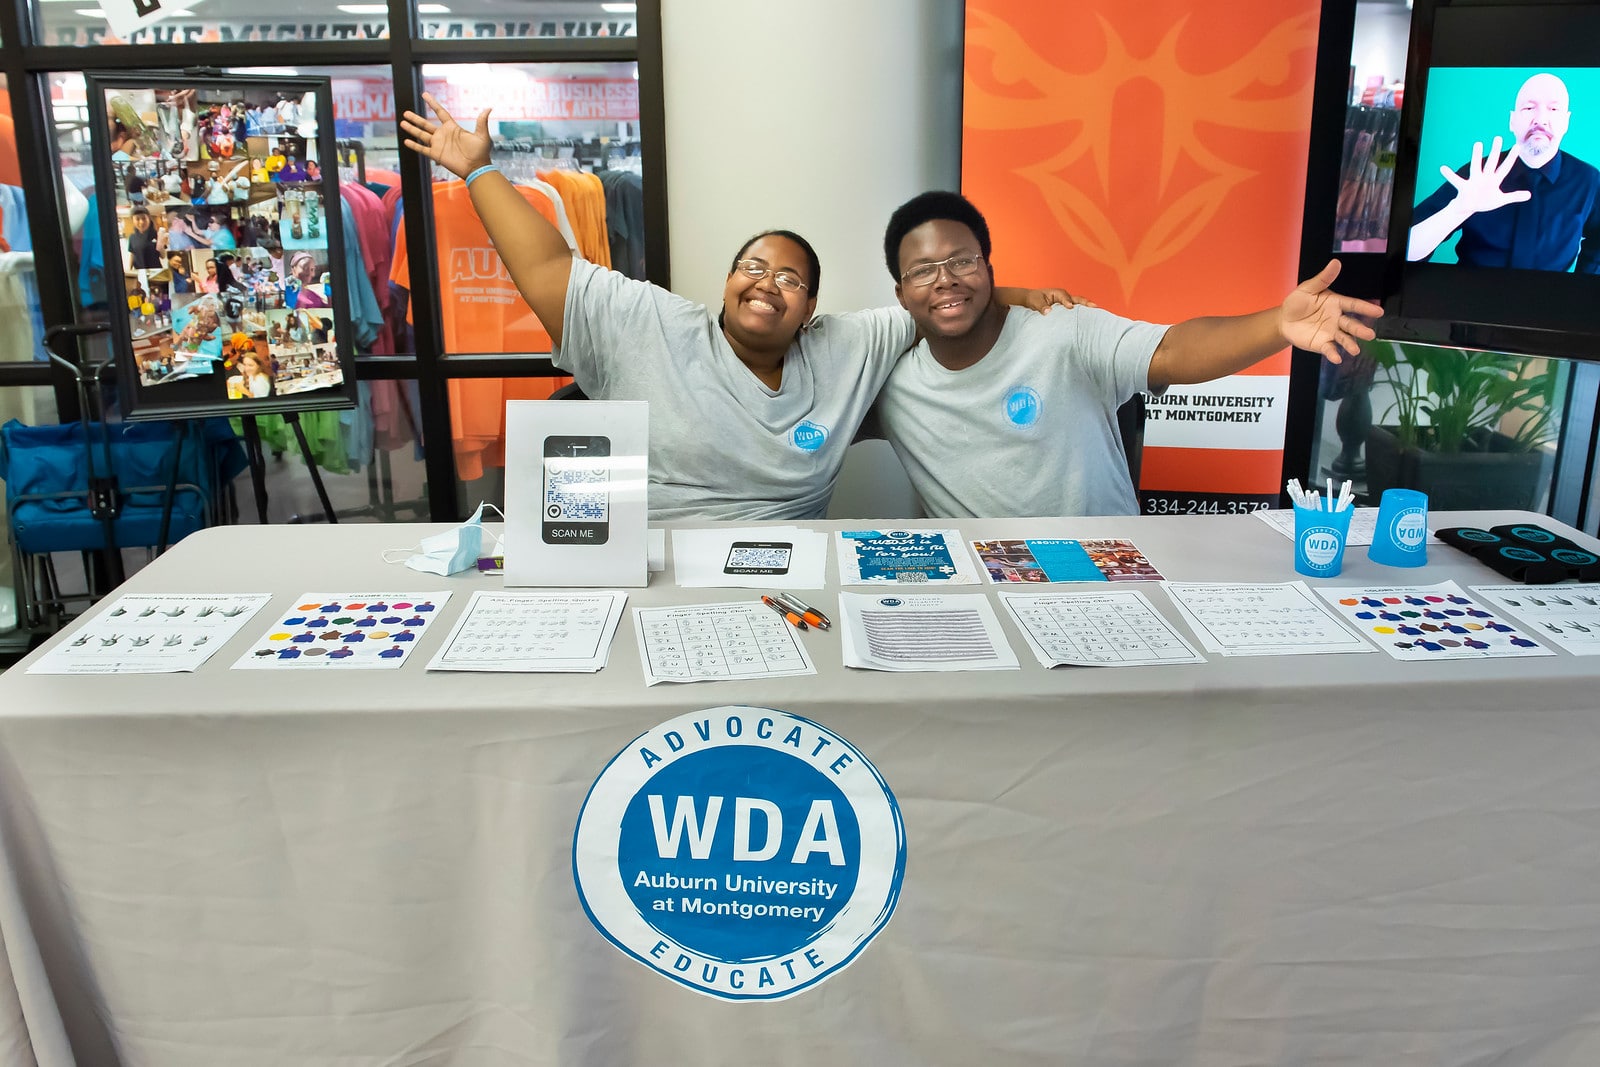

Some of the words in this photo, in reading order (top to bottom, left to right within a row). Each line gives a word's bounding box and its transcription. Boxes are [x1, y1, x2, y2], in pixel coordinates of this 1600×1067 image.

[548, 83, 637, 100] BUSINESS
[572, 101, 606, 118] ARTS
[1008, 396, 1036, 412] WDA
[1192, 395, 1274, 408] UNIVERSITY
[1145, 409, 1162, 420] AT
[1165, 410, 1262, 423] MONTGOMERY
[796, 430, 822, 441] WDA
[1146, 498, 1270, 515] 334-244-3578
[551, 529, 577, 538] SCAN
[579, 529, 594, 538] ME
[1398, 528, 1424, 539] WDA
[1309, 538, 1337, 550] WDA
[639, 715, 853, 776] ADVOCATE
[647, 794, 846, 867] WDA
[633, 870, 718, 891] Auburn
[725, 873, 839, 900] University
[652, 898, 675, 912] at
[681, 897, 825, 923] Montgomery
[649, 939, 825, 990] EDUCATE
